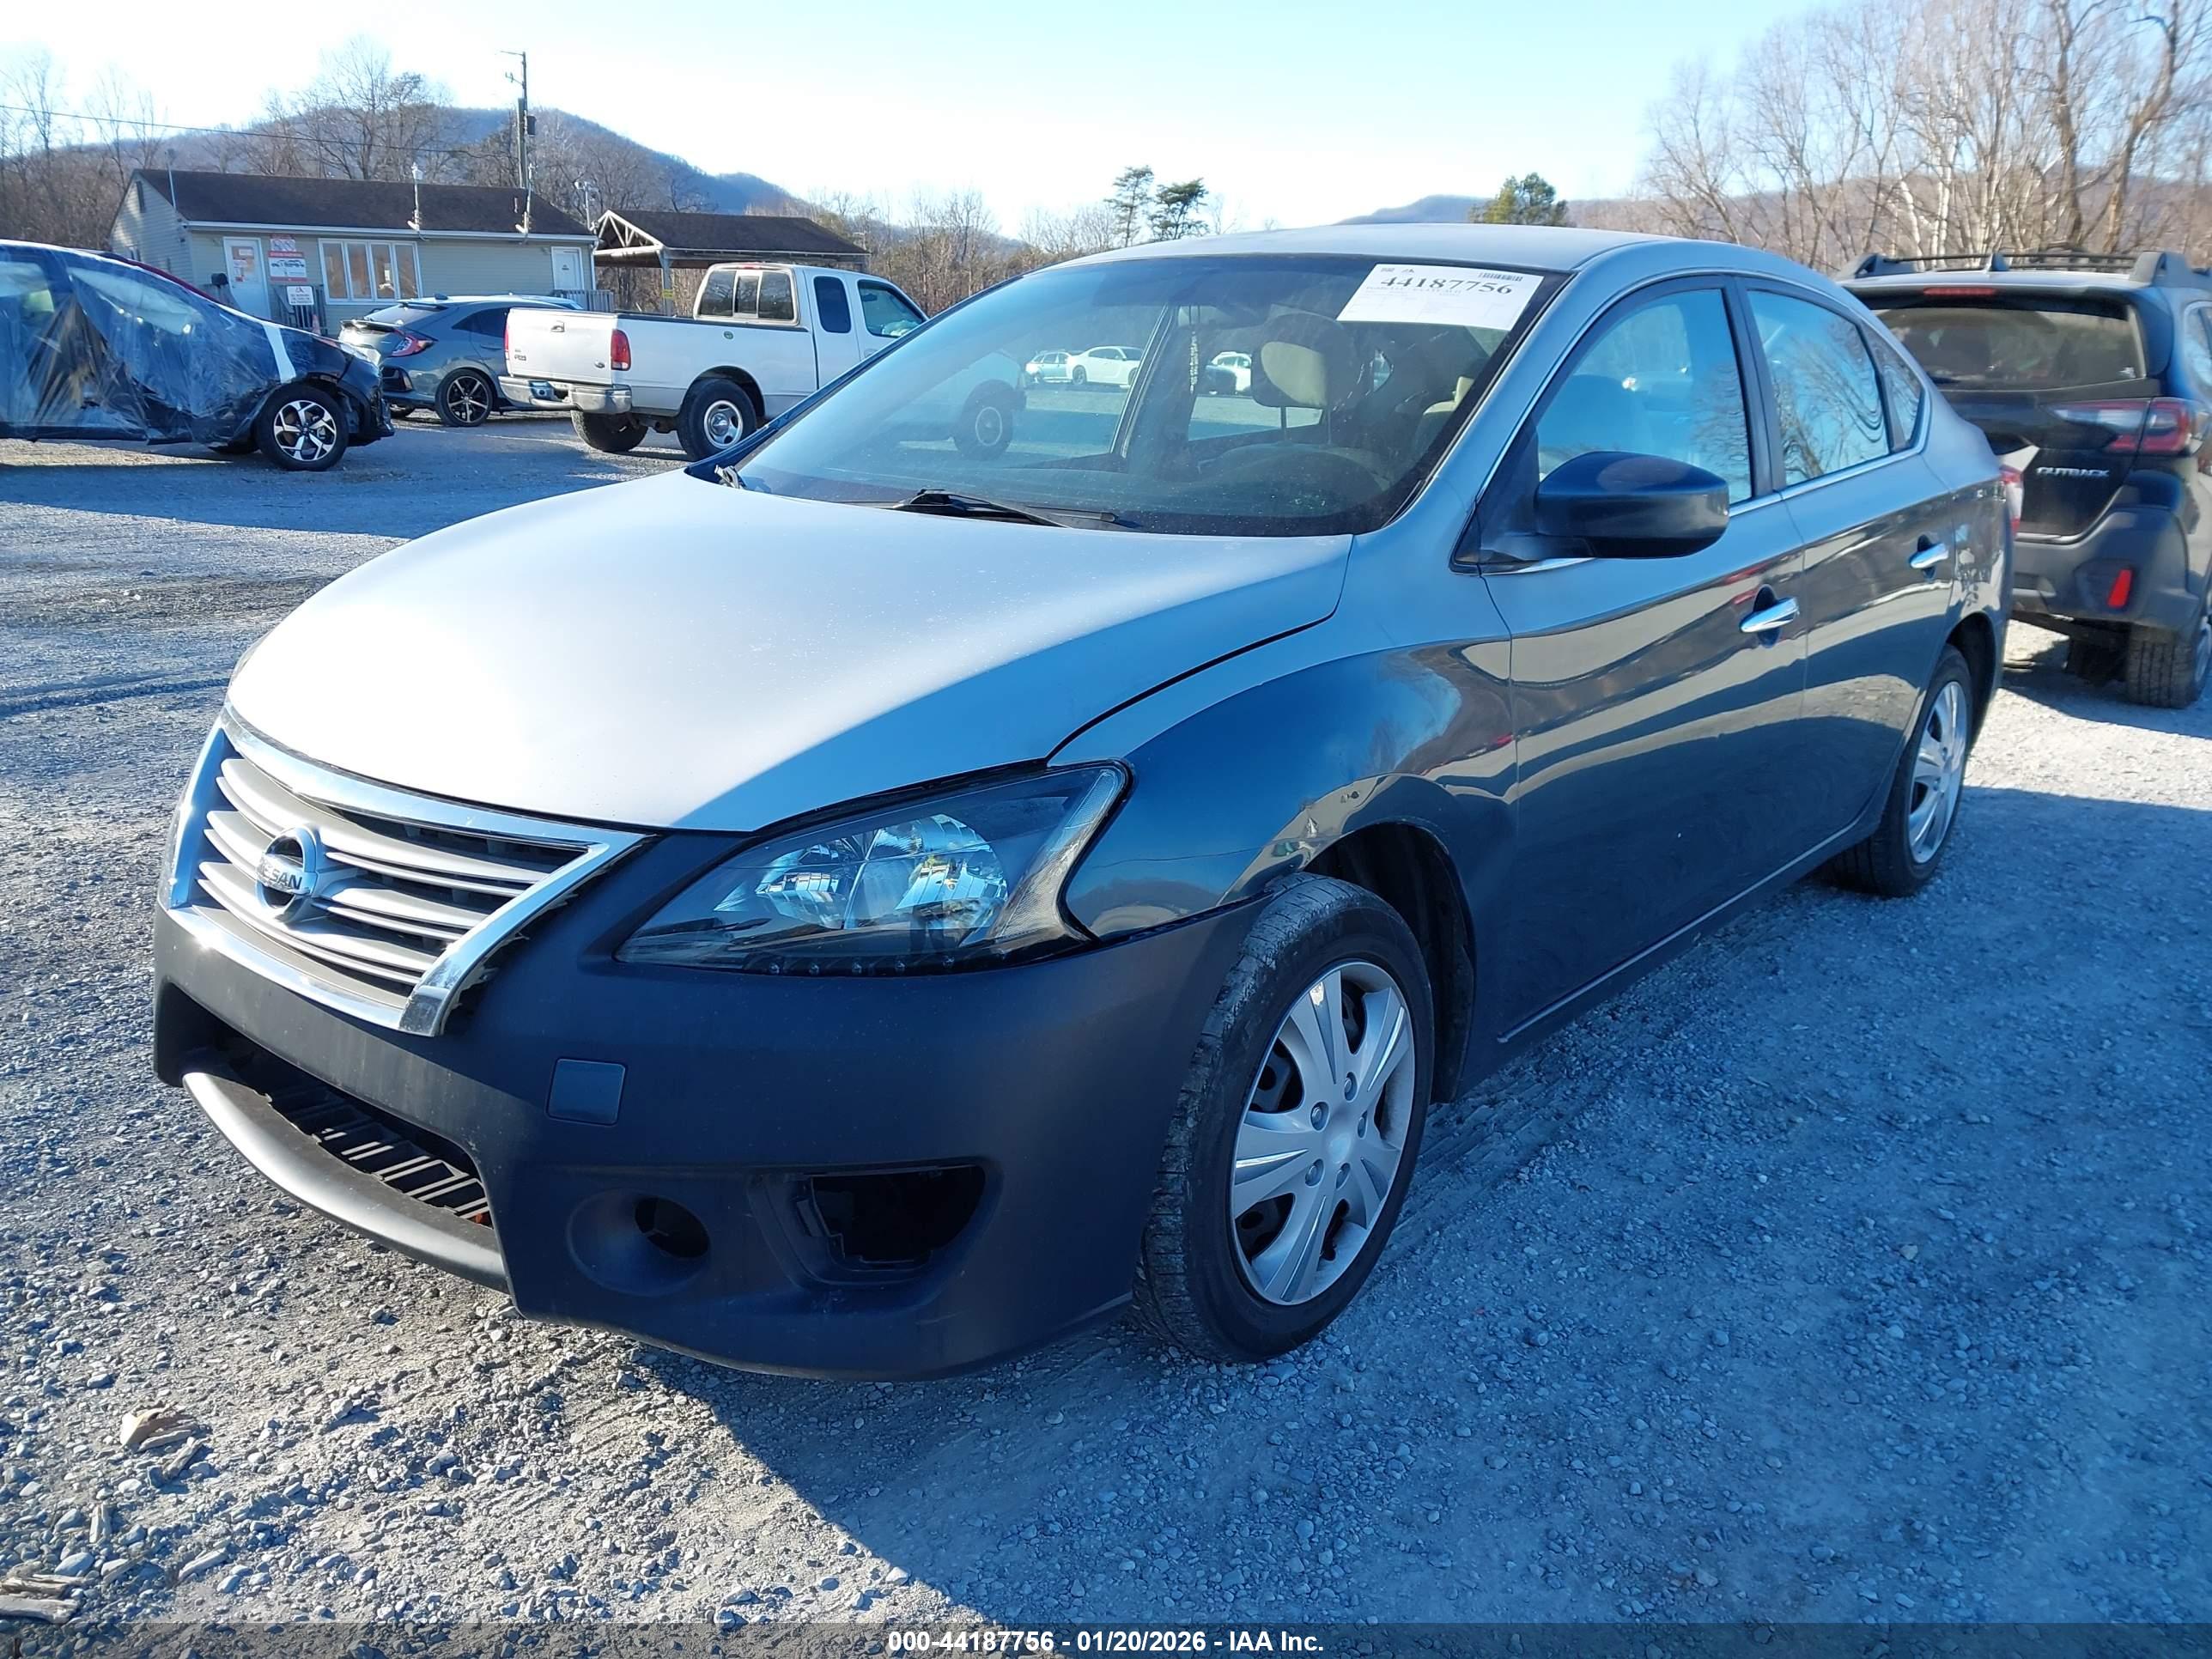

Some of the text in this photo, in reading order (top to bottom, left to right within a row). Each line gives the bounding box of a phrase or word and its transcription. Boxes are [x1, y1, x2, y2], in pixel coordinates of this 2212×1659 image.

[1380, 276, 1513, 295] 44187756
[2036, 465, 2110, 477] OUTBACK
[257, 856, 303, 890] SSAN
